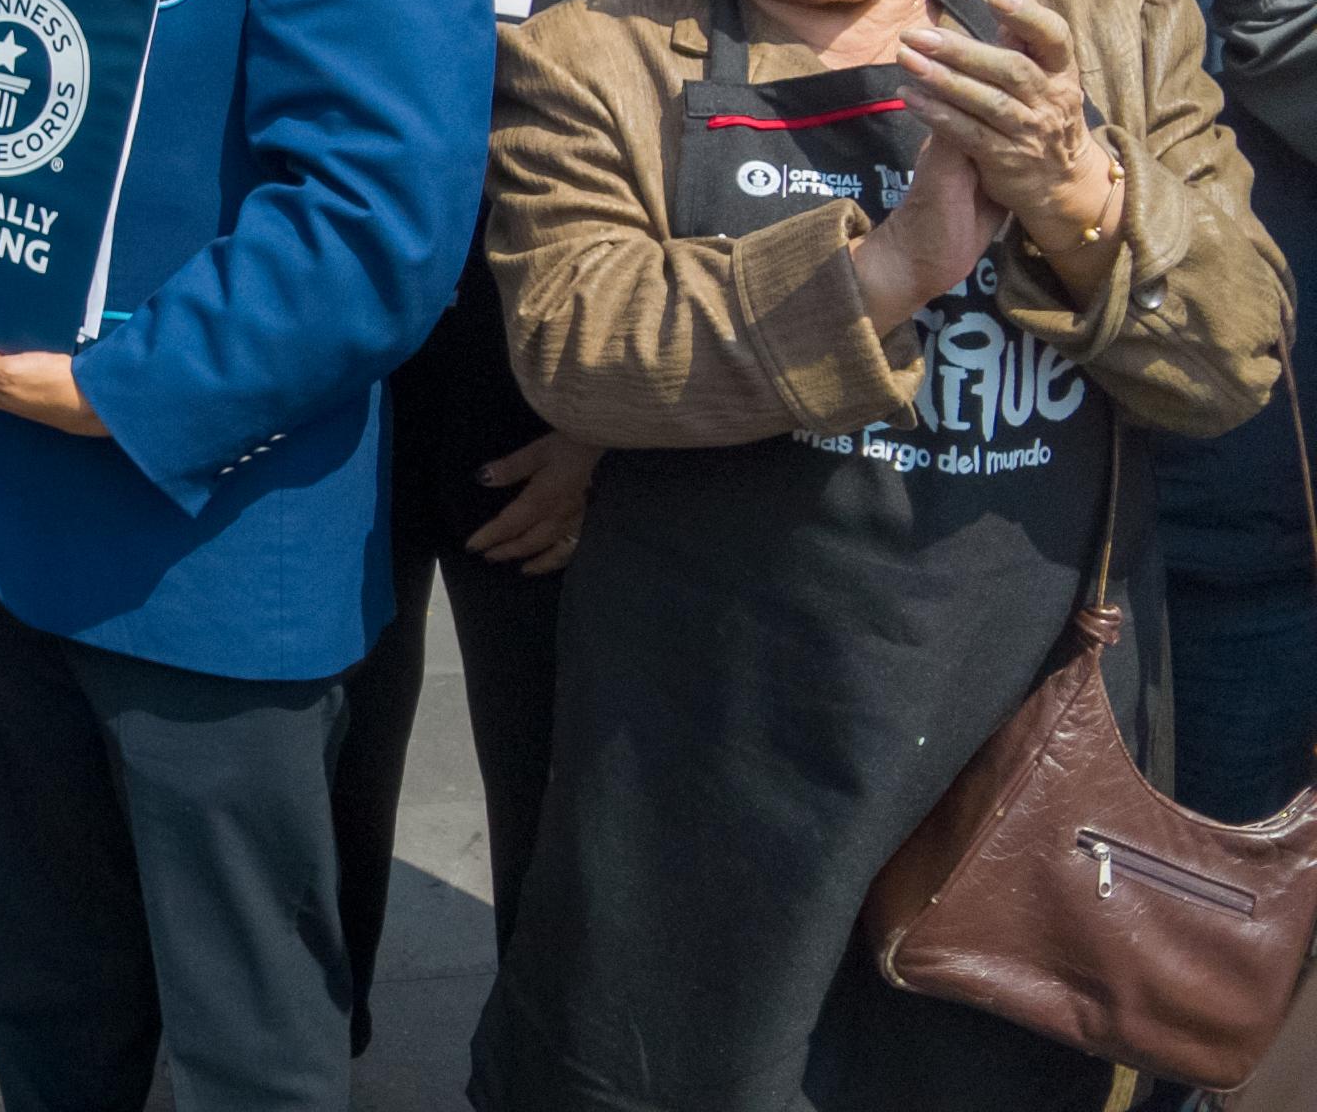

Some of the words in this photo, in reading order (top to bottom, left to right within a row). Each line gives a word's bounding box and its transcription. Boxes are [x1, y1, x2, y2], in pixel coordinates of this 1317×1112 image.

[788, 169, 863, 187] OFFICIAL
[788, 181, 863, 199] ATTEMPT
[862, 429, 931, 473] largo
[937, 437, 980, 475] del
[986, 437, 1052, 476] mundo
